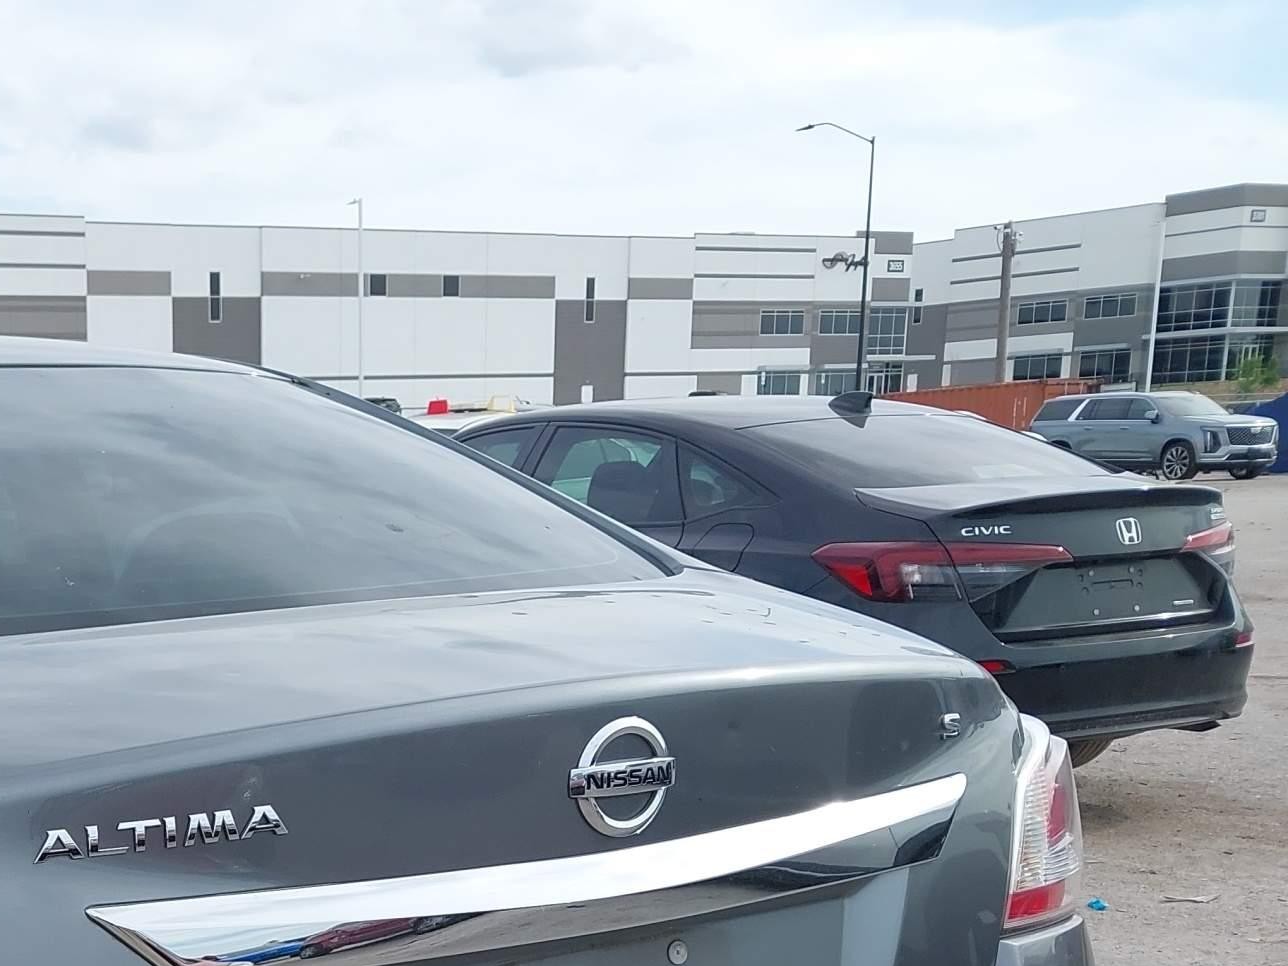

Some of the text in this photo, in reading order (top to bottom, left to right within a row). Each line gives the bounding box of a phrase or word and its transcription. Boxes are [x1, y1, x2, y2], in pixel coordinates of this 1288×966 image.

[961, 525, 1012, 537] CIVIC
[943, 712, 961, 740] S
[585, 761, 673, 790] NISSAN
[33, 804, 288, 864] ALTIMA
